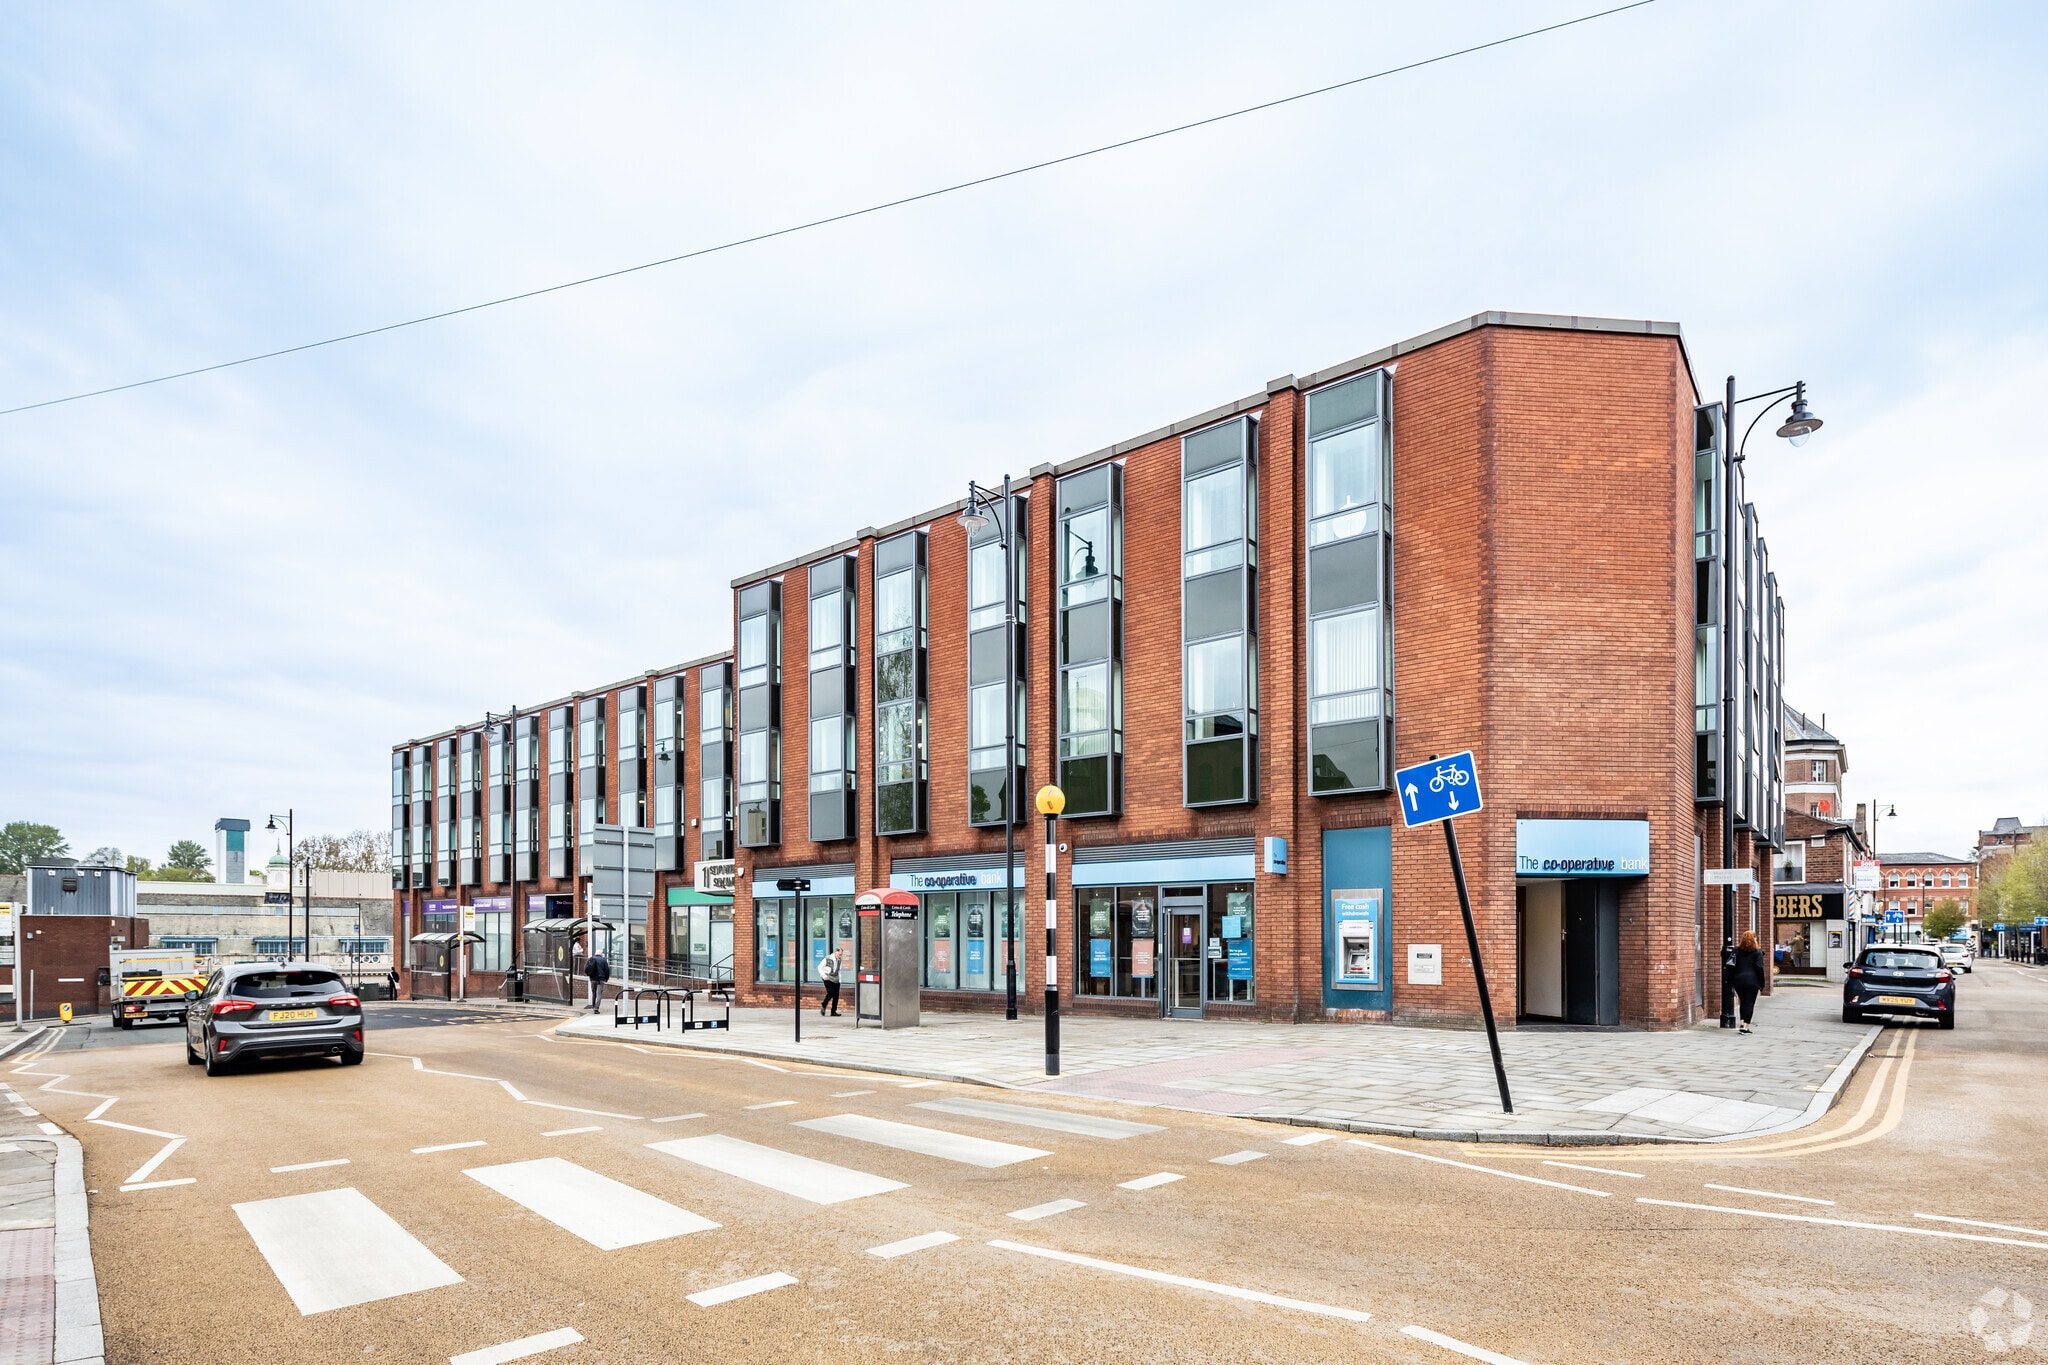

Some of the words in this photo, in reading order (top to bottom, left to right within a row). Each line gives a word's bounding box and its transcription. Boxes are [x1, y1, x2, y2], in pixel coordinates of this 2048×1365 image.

[1519, 855, 1539, 870] The
[1543, 857, 1615, 873] co-operative
[1621, 856, 1648, 870] bank
[910, 874, 924, 887] The
[924, 873, 977, 889] co-operative
[981, 872, 1002, 885] bank
[891, 910, 912, 919] Telephone
[1774, 894, 1823, 918] BERS
